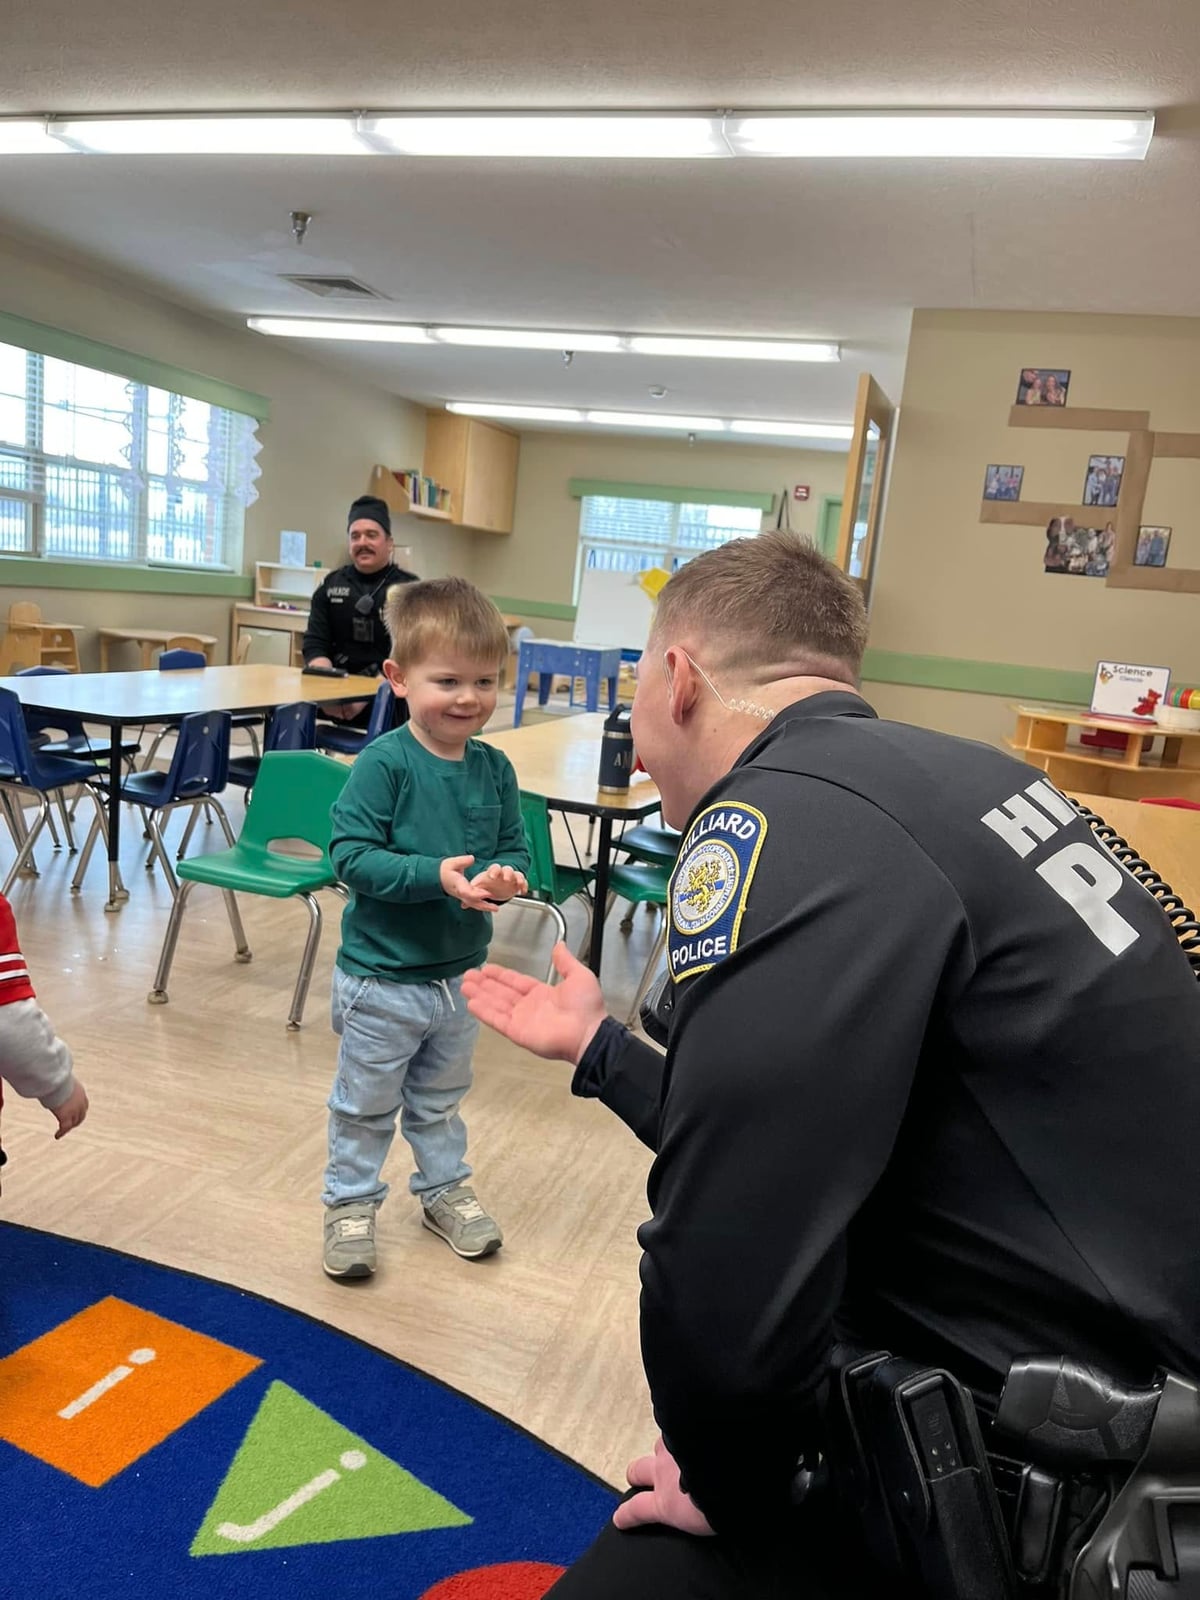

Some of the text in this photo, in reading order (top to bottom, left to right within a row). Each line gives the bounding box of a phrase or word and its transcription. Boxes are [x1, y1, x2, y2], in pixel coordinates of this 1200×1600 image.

[1113, 665, 1153, 677] Science
[980, 777, 1083, 859] HI
[1035, 832, 1156, 956] P
[672, 935, 727, 970] POLICE
[57, 1347, 156, 1420] i
[216, 1449, 367, 1542] j
